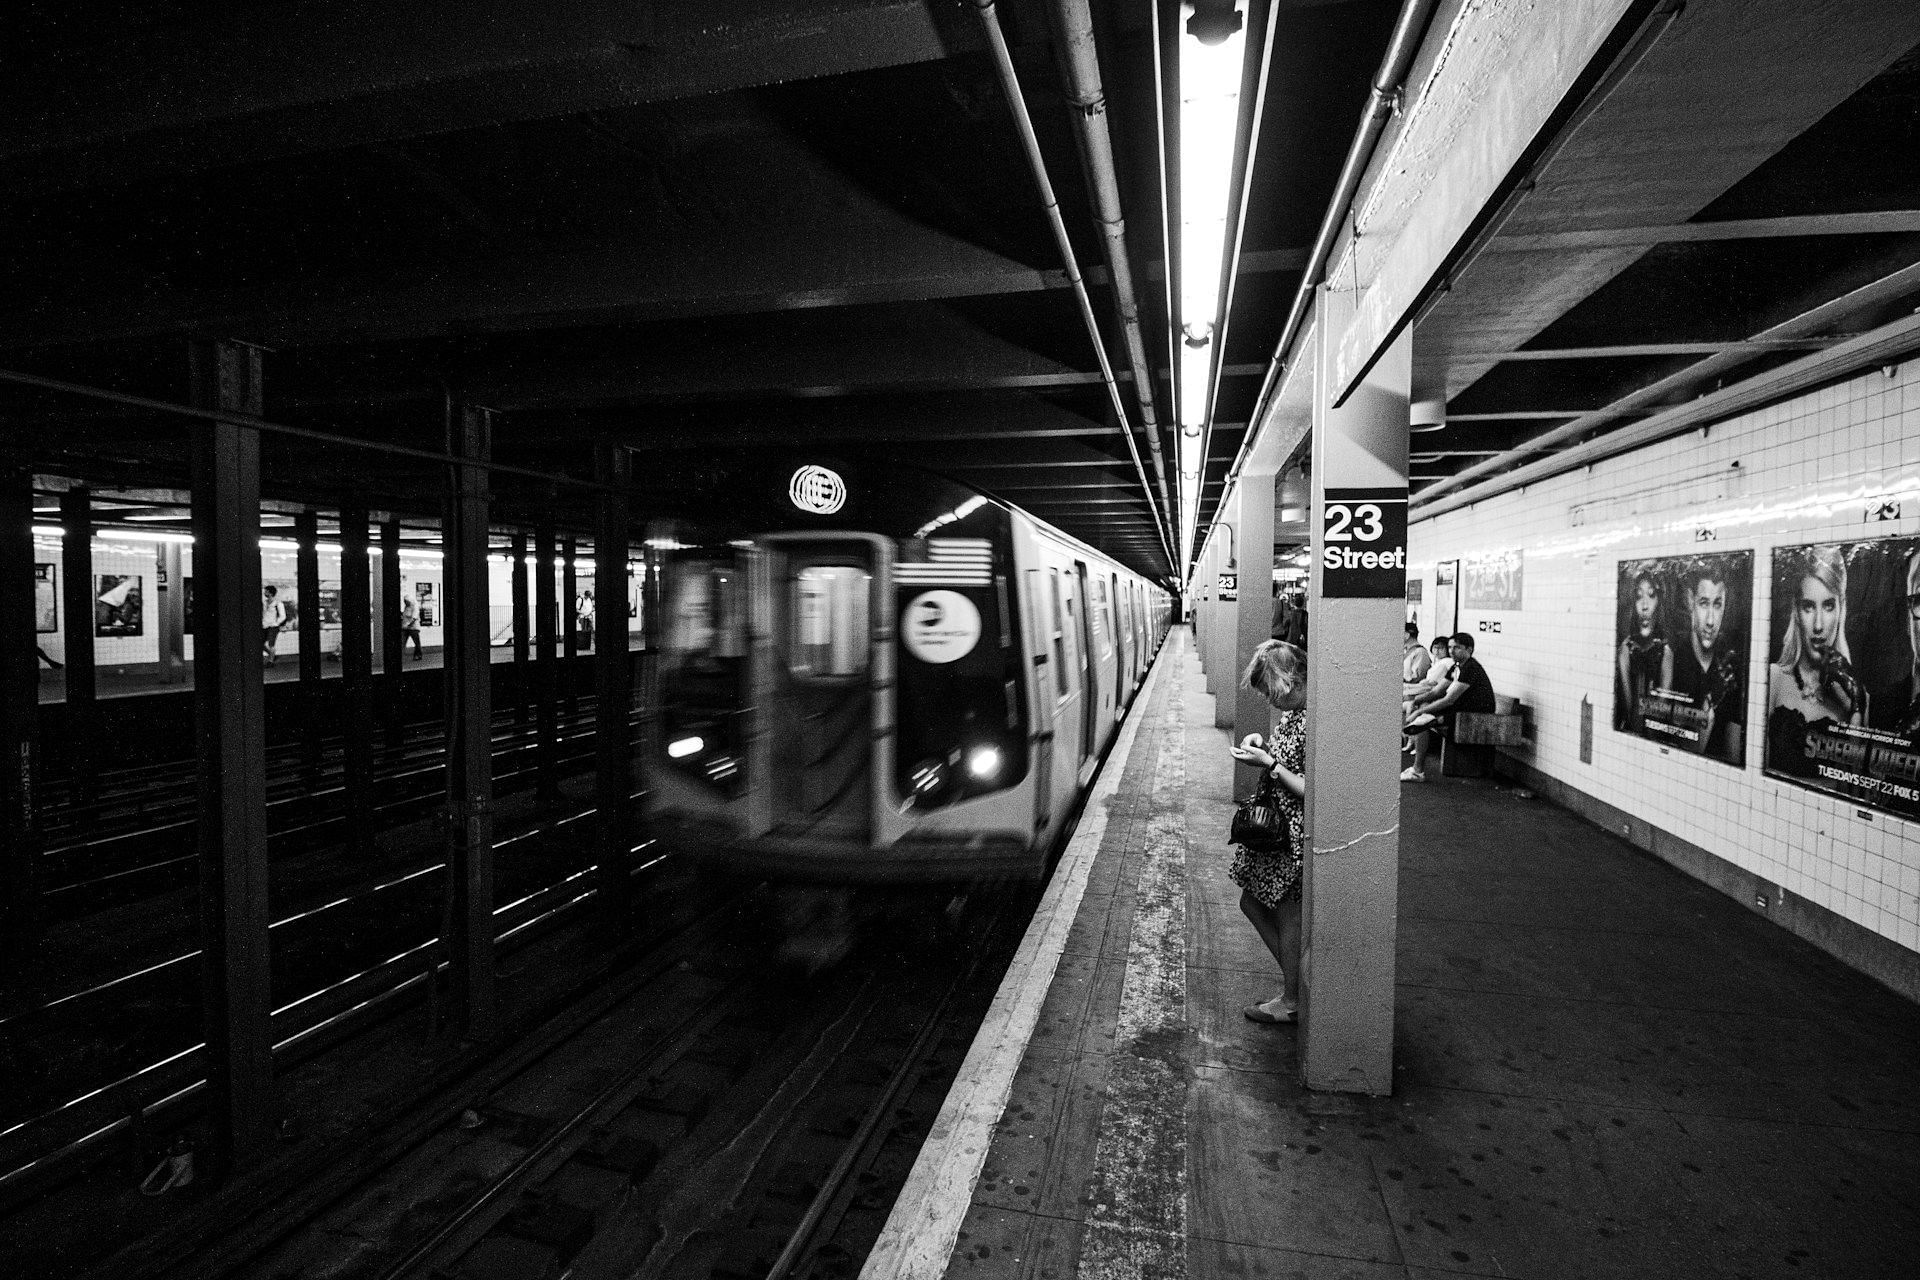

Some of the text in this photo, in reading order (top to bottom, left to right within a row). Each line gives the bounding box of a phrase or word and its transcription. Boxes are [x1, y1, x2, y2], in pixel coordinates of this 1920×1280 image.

[1324, 504, 1383, 541] 23
[1323, 546, 1405, 569] Street
[1219, 577, 1234, 588] 23
[1804, 733, 1866, 769] SCREAM
[1871, 734, 1894, 744] HORROR
[1894, 738, 1912, 747] STORY
[1818, 764, 1920, 801] TUESDAYS SEPT 22 FOX 5
